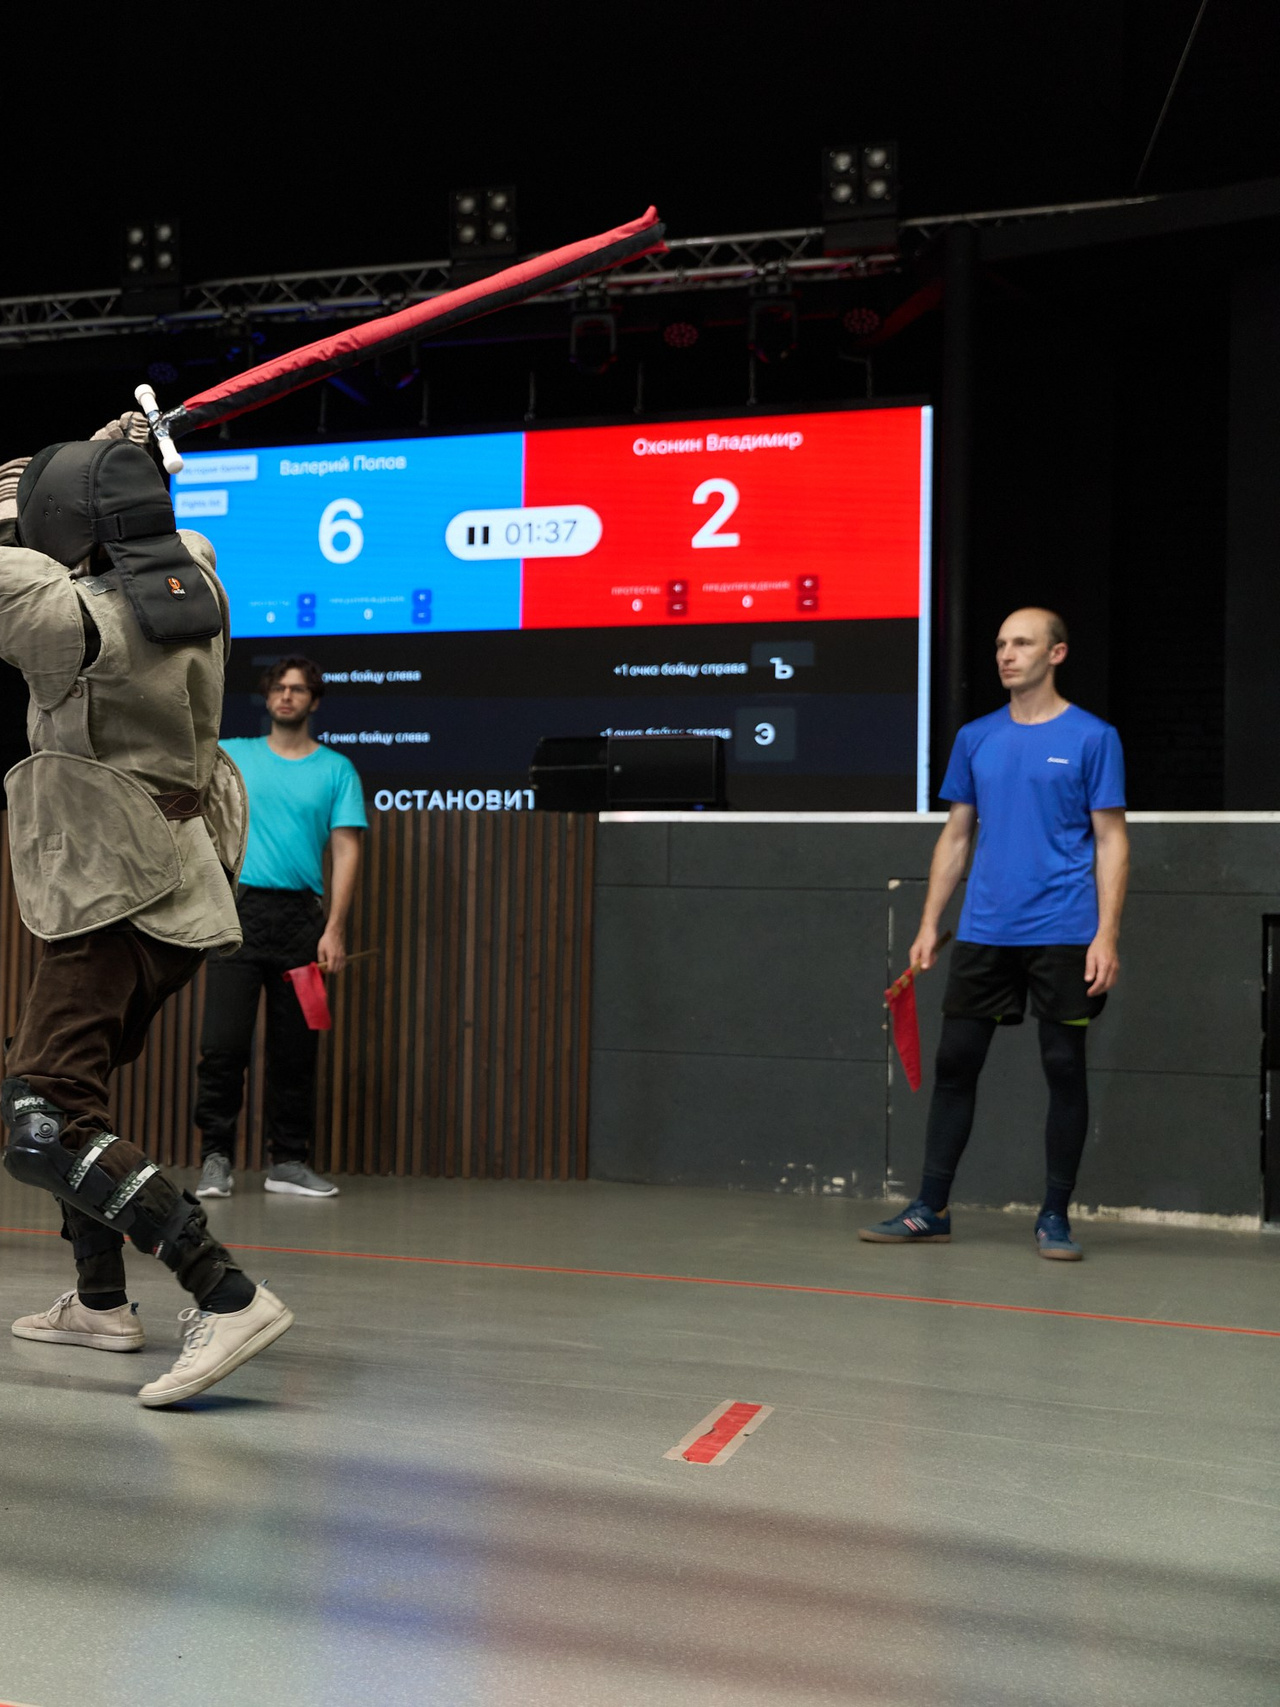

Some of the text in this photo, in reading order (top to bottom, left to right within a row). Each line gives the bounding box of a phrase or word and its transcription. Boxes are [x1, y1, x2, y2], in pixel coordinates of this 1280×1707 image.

[632, 431, 804, 456] Охонин Владимир
[279, 454, 407, 477] Валерий Попов
[691, 478, 740, 548] 2
[318, 498, 364, 564] 6
[504, 519, 578, 545] 01:37
[350, 669, 384, 684] бойцу
[386, 670, 422, 682] слева
[629, 665, 660, 676] очко
[661, 662, 700, 678] бойцу
[700, 662, 749, 677] справа
[769, 657, 795, 680] Ъ
[330, 733, 357, 744] очко
[358, 731, 393, 746] бойцу
[395, 732, 430, 743] слева
[754, 722, 776, 746] Э
